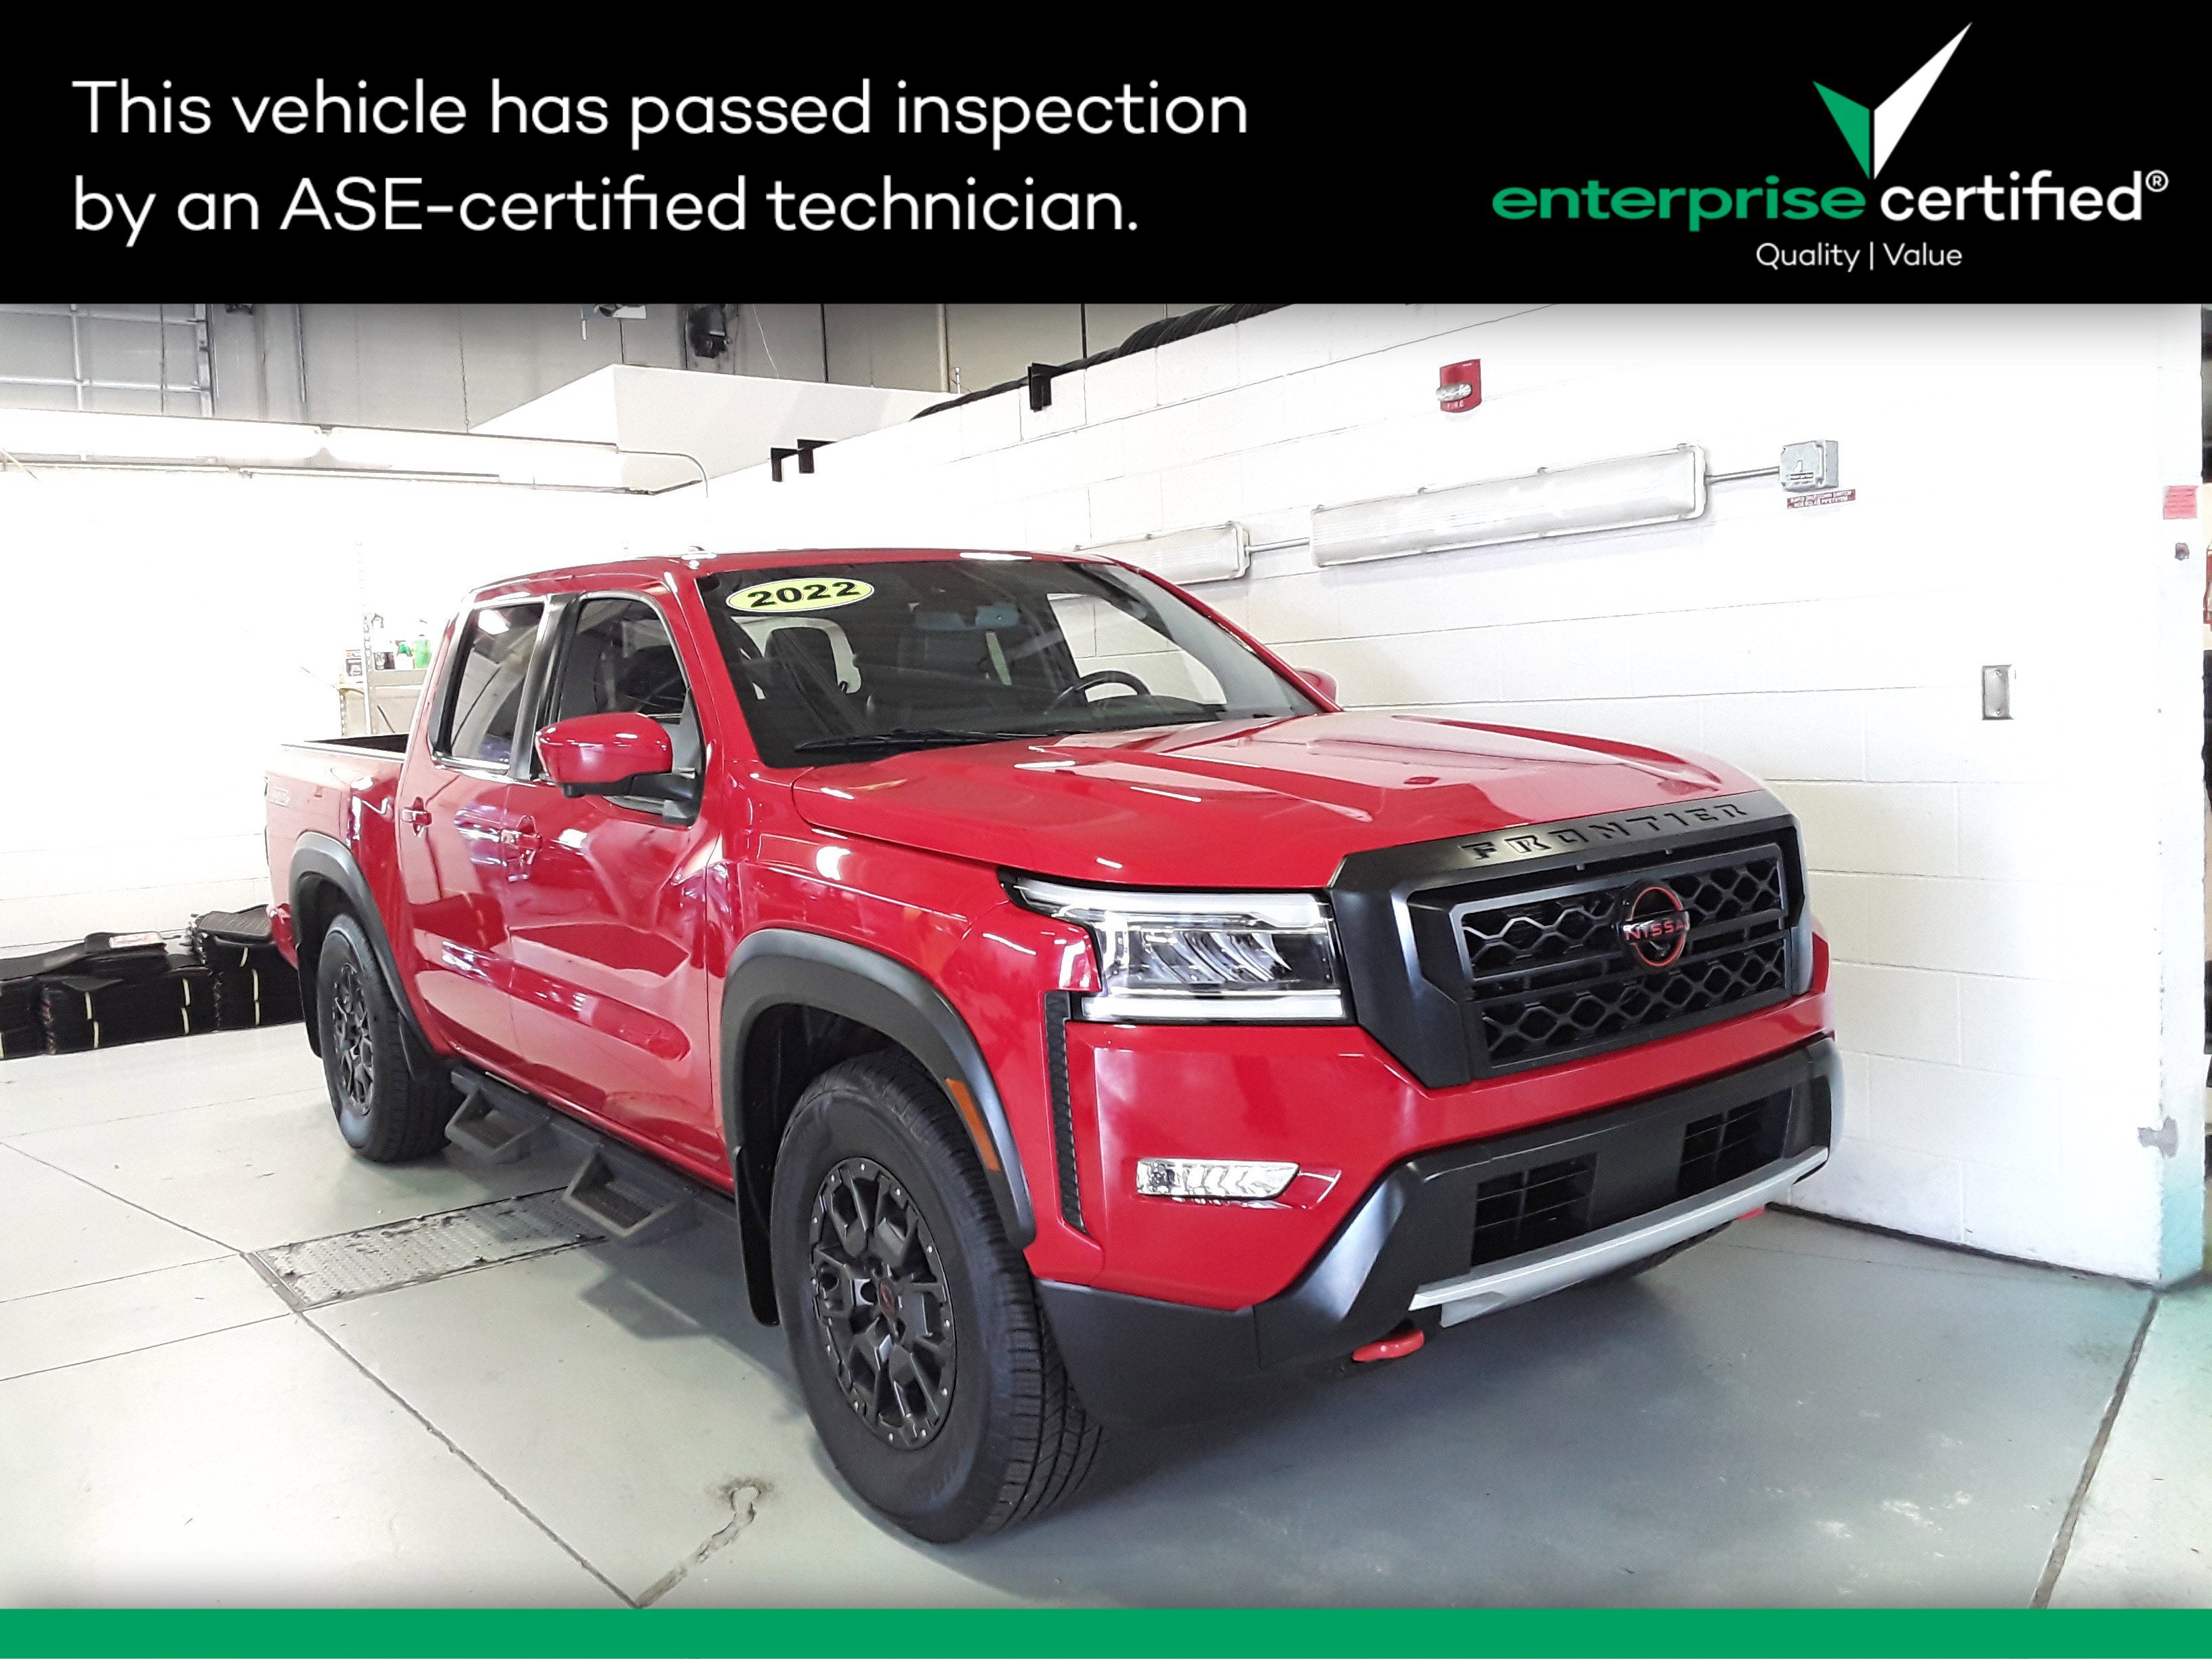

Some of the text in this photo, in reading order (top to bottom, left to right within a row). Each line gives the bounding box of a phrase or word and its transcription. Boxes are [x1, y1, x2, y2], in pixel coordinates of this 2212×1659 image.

[747, 581, 862, 608] 2022
[1459, 803, 1748, 860] FRONTIER
[1624, 920, 1686, 941] NISSA
